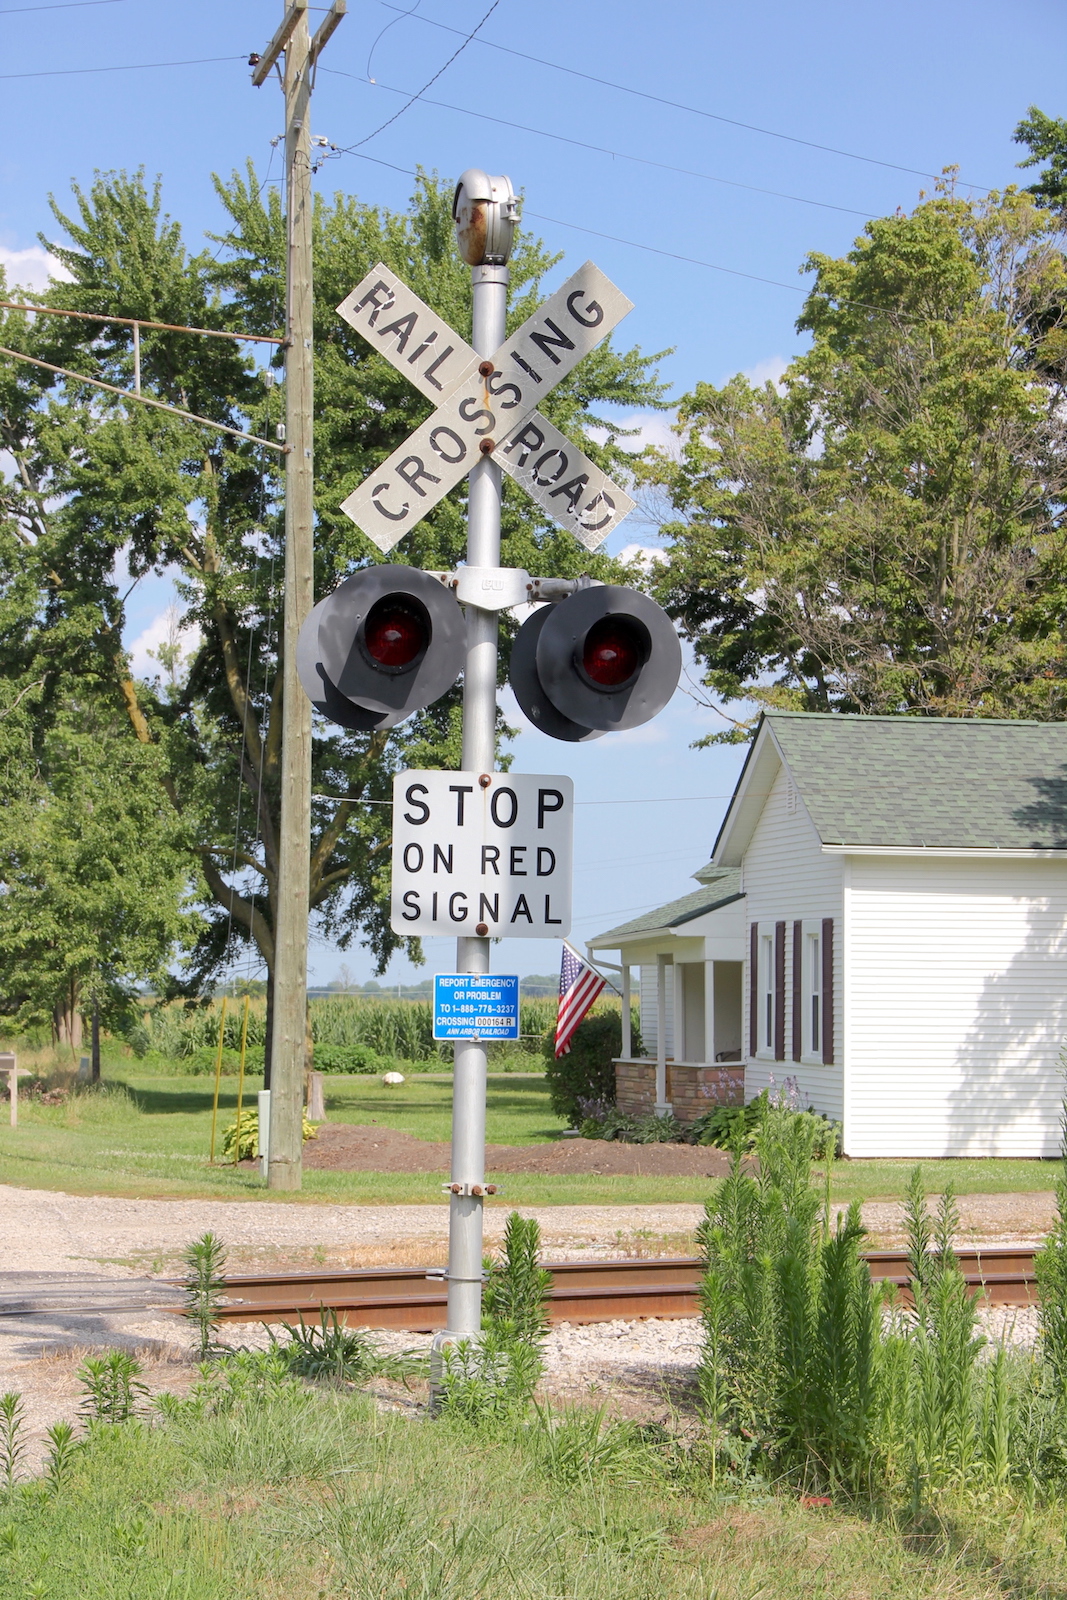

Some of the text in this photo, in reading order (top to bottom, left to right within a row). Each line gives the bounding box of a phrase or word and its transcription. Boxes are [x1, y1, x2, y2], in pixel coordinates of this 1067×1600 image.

[353, 280, 616, 531] RAIL ROAD
[370, 289, 605, 521] CROSSING
[403, 783, 564, 829] STOP
[403, 842, 556, 877] ON RED
[401, 890, 562, 924] SIGNAL
[439, 978, 516, 988] REPORT EMERGENCY
[453, 991, 502, 1000] OR PROBLEM
[440, 1004, 515, 1014] TO 1-888-778-3237
[436, 1016, 475, 1026] CROSSING
[506, 1018, 512, 1026] R
[460, 1028, 480, 1036] ARBOR
[480, 1028, 510, 1036] RAILROAD
